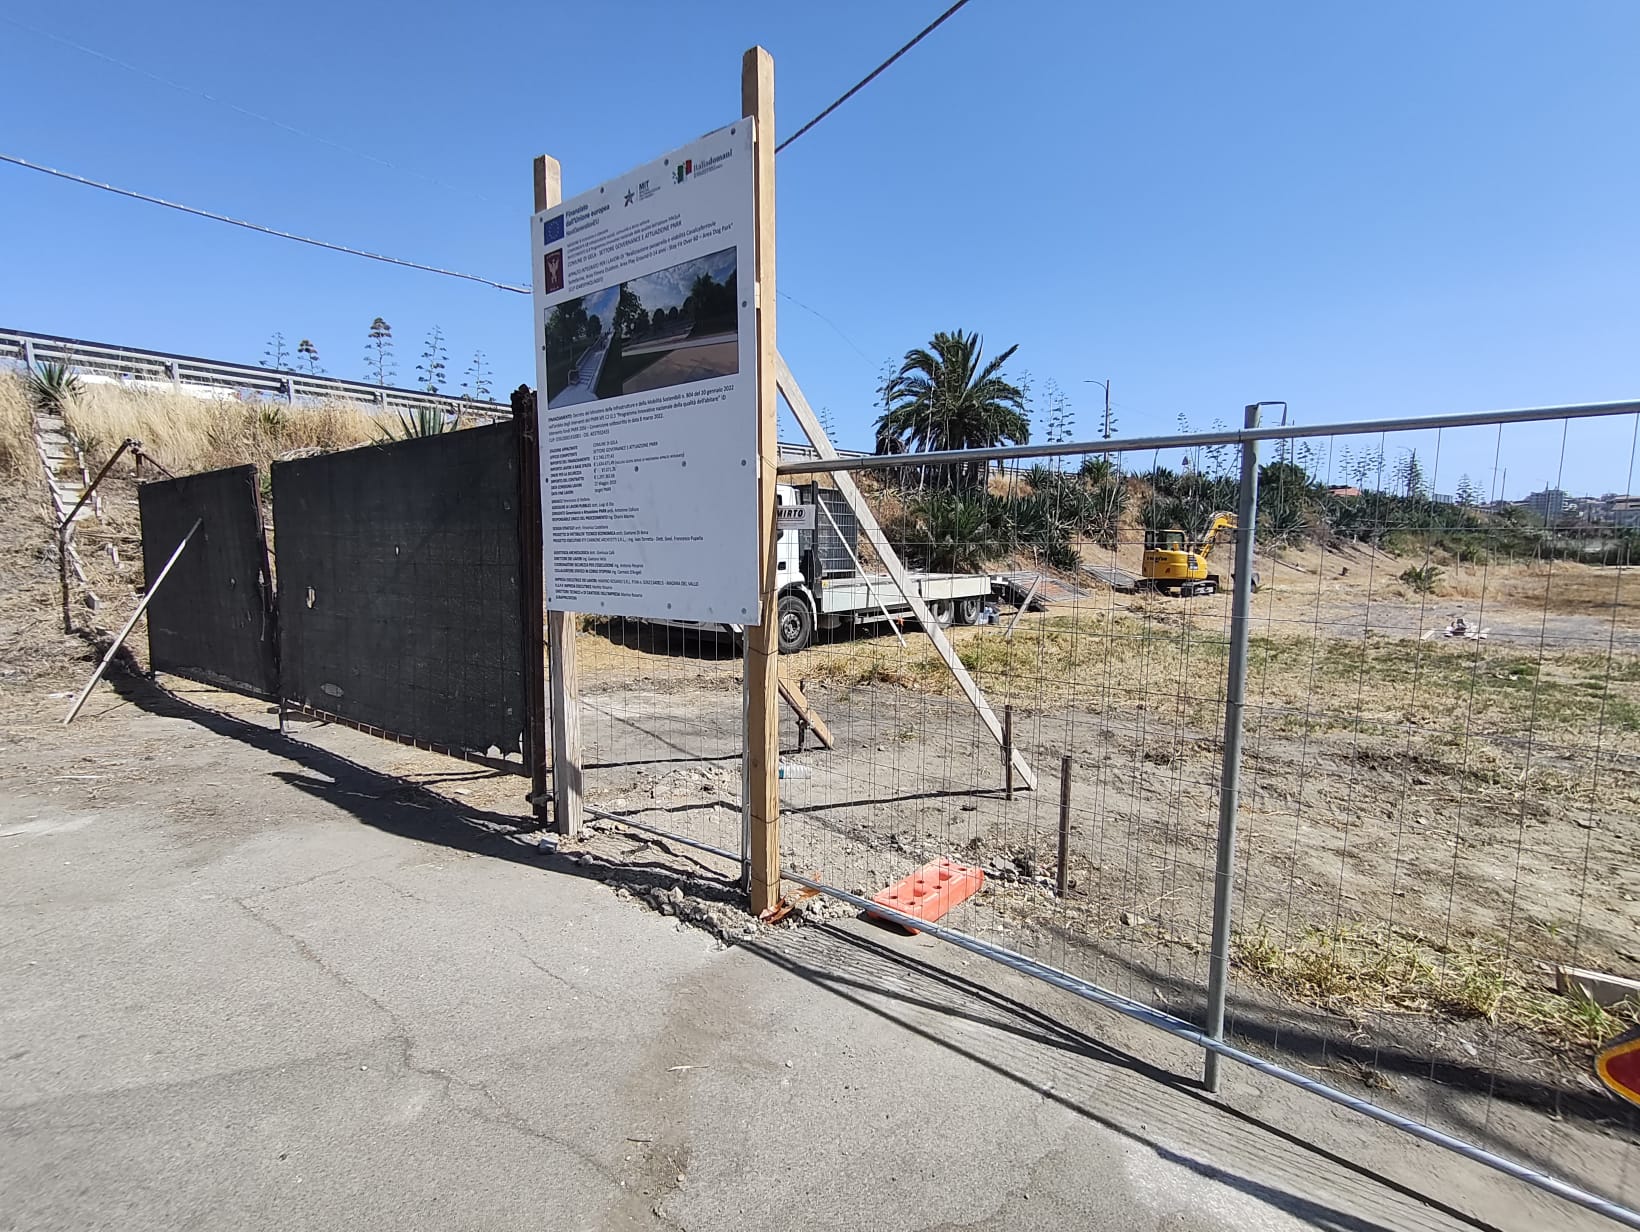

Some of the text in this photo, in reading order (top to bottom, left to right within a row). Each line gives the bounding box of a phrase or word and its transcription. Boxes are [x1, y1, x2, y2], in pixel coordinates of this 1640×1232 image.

[694, 148, 732, 173] Italiadomani
[639, 180, 649, 192] MIT
[566, 203, 588, 219] Finanziato
[591, 202, 610, 218] europea
[599, 245, 614, 256] SETTORE
[616, 235, 640, 250] GOVERNANCE
[645, 224, 670, 239] ATTUAZIONE
[684, 237, 692, 246] Over
[703, 230, 712, 239] Area
[713, 227, 721, 236] Dog
[707, 388, 723, 396] gennaio
[777, 509, 804, 518] MIRTO
